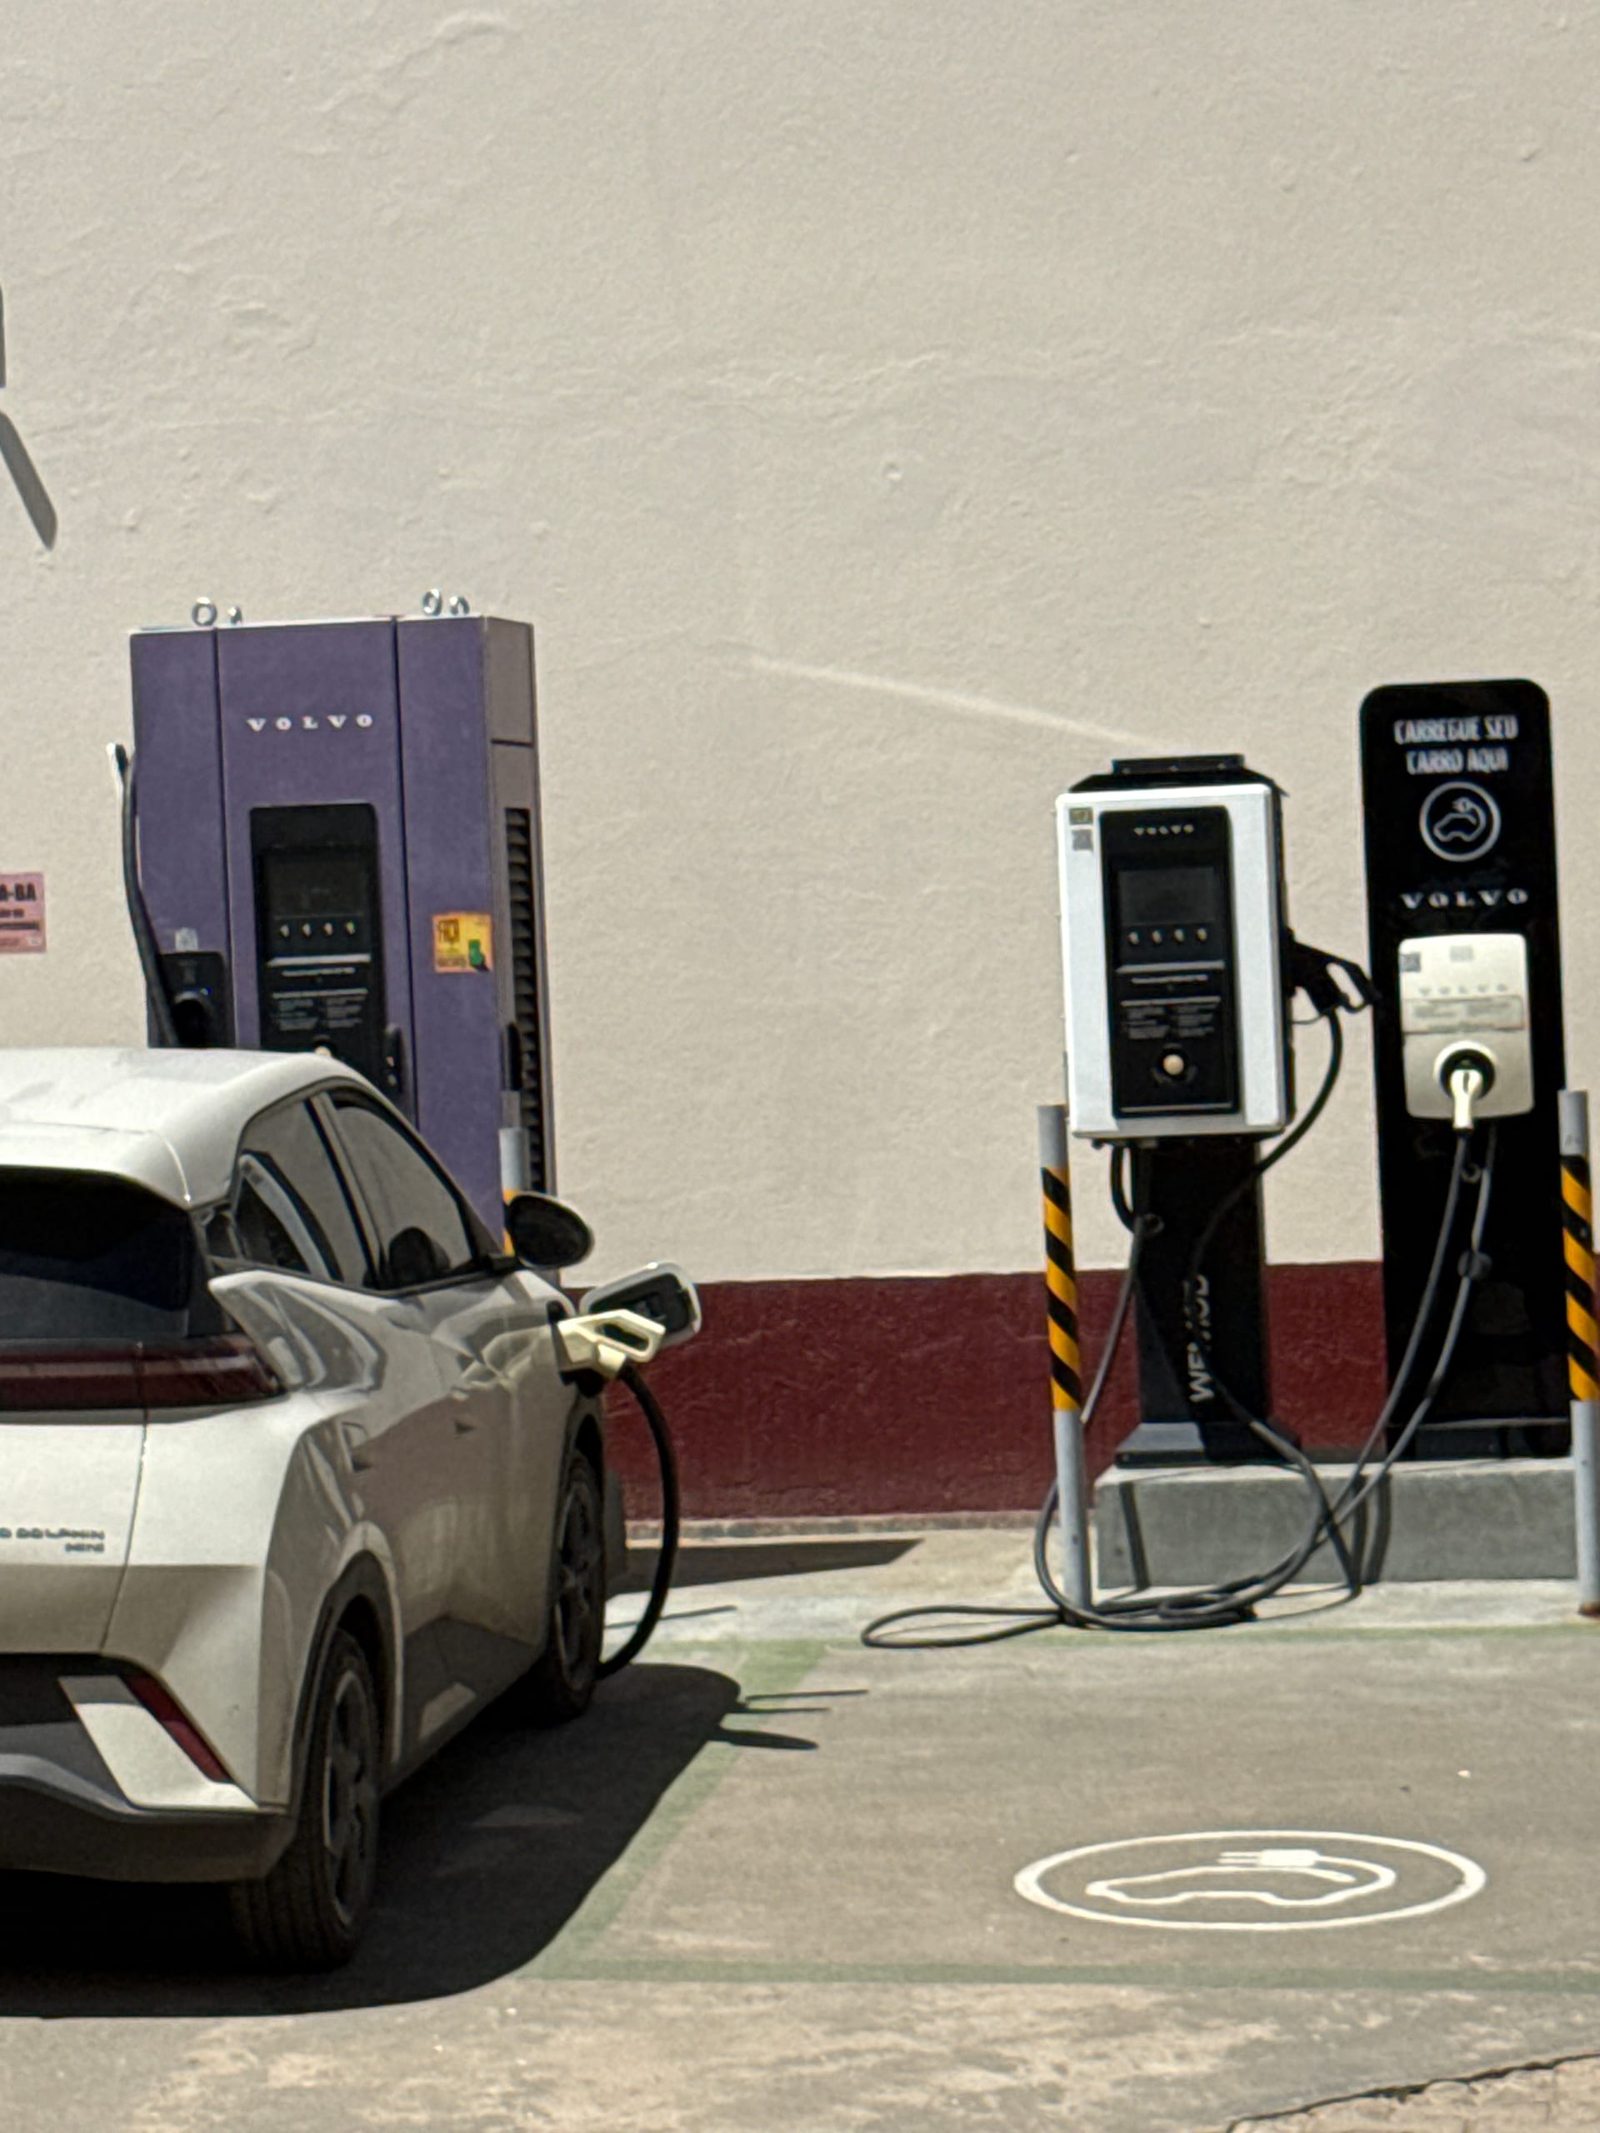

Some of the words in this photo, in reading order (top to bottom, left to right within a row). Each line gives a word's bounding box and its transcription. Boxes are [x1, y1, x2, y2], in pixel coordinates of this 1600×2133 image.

[246, 713, 373, 732] VOLVO
[1393, 716, 1481, 745] CARREGUE
[1484, 714, 1519, 740] SEU
[1406, 748, 1464, 775] CARRO
[1467, 747, 1509, 774] AQUI
[1401, 888, 1529, 909] VOLVO
